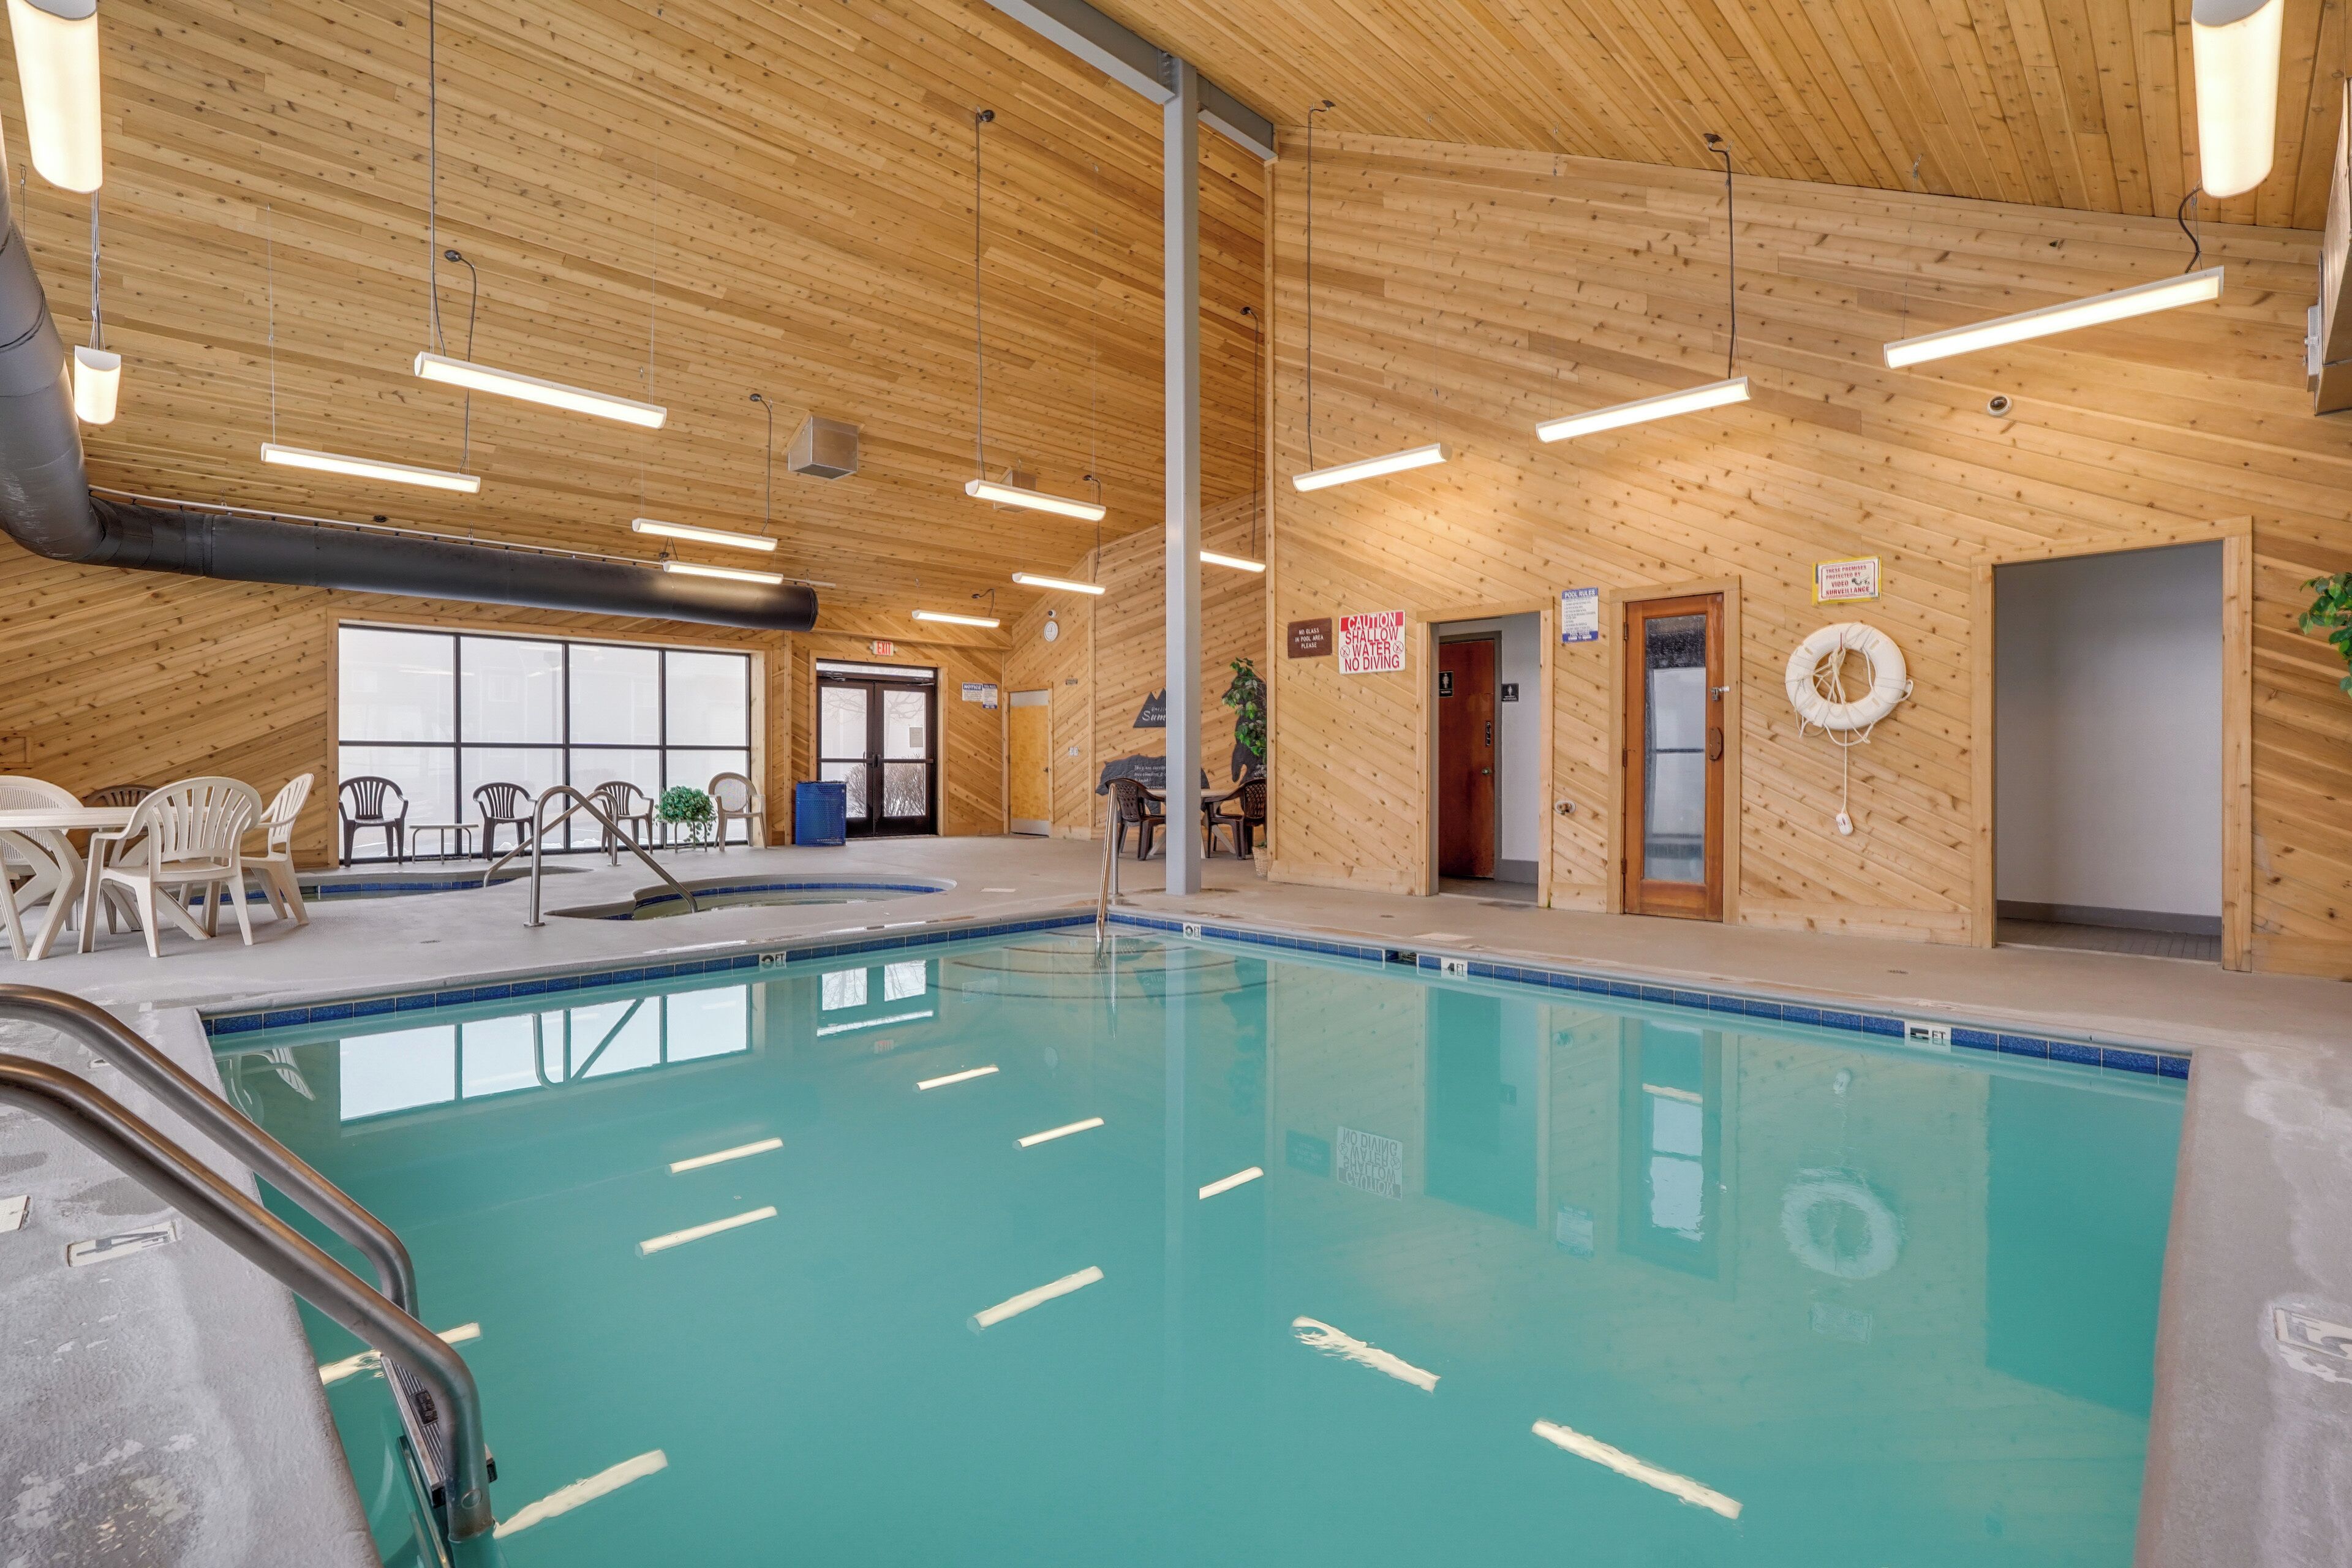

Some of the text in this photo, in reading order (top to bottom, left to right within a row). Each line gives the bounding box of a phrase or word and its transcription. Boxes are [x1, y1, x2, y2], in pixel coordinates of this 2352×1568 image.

[1578, 589, 1596, 597] RULES
[1826, 586, 1870, 595] SURVEILLANCE
[1348, 613, 1396, 630] CAUTION
[1345, 627, 1399, 644] SHALLOW
[877, 641, 892, 656] EXIT
[1352, 641, 1391, 657] WATER
[1344, 654, 1400, 673] NO DIVING
